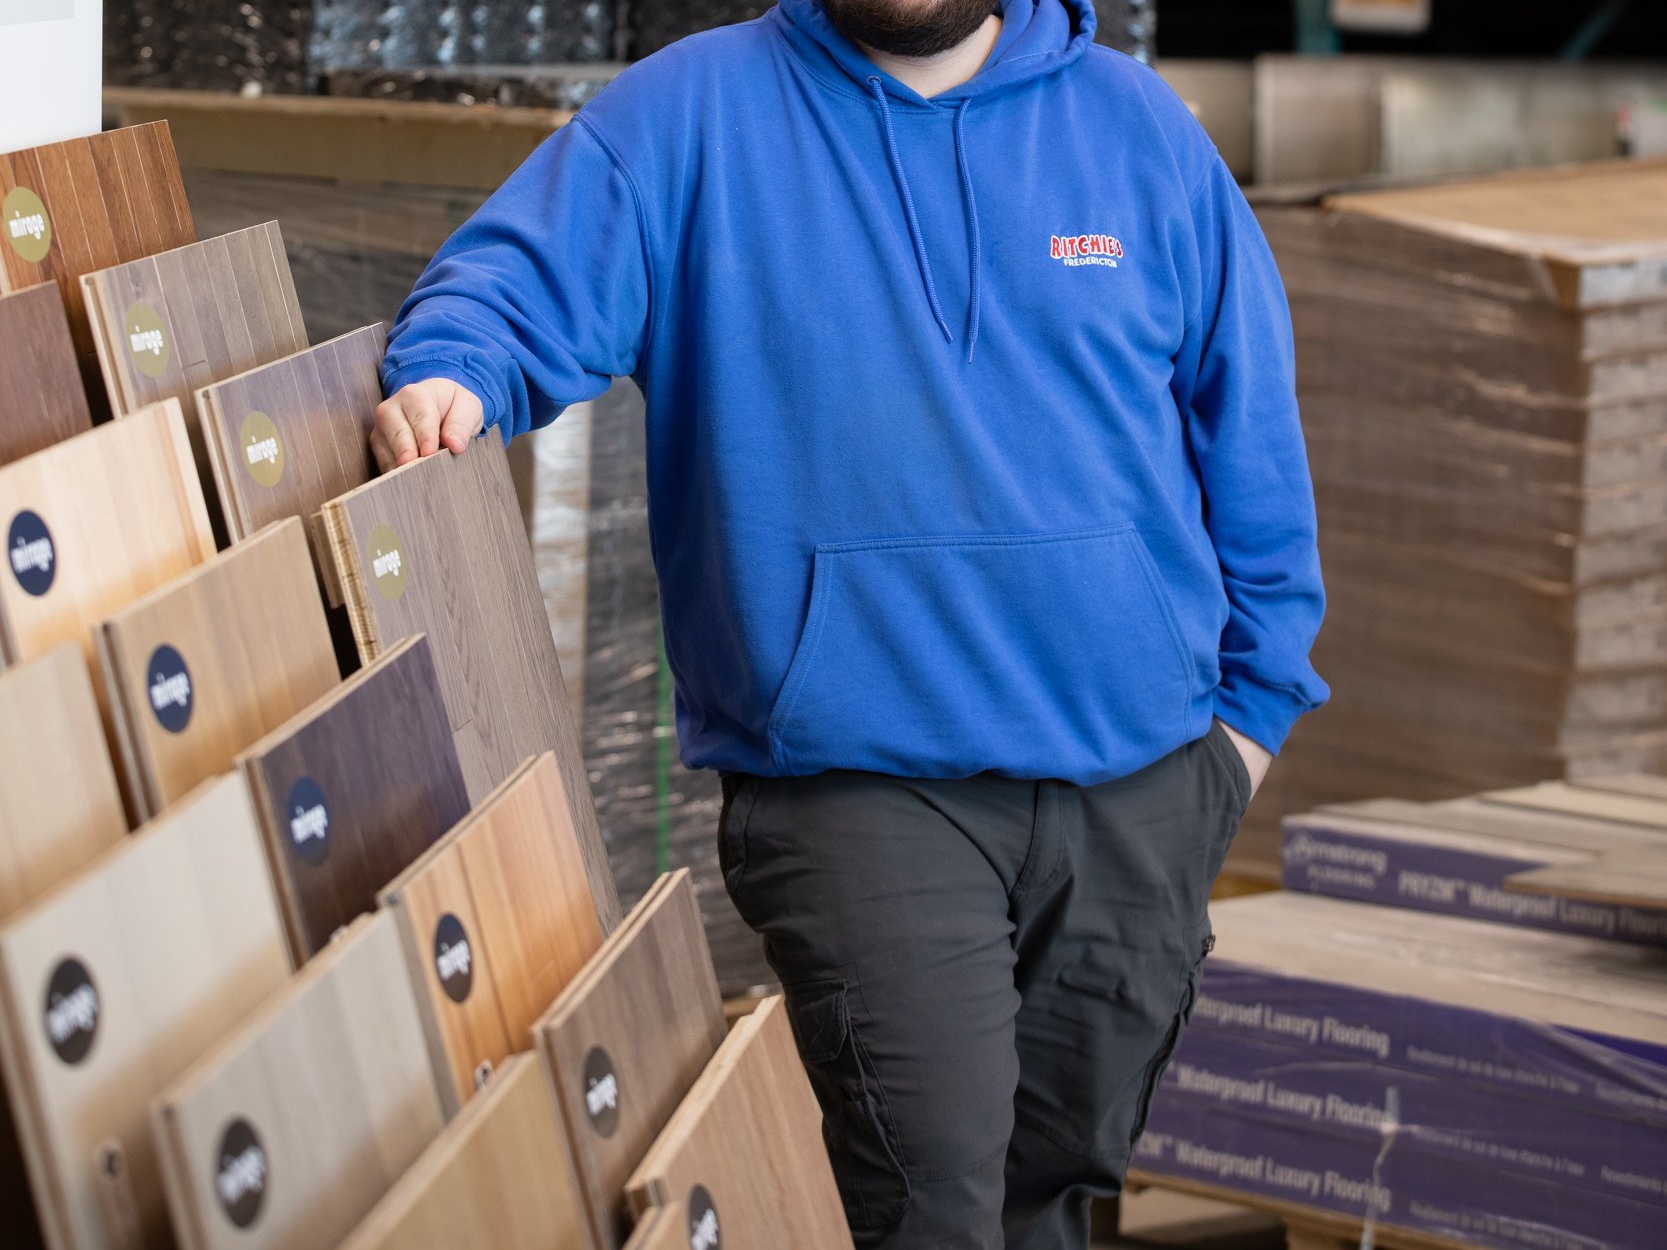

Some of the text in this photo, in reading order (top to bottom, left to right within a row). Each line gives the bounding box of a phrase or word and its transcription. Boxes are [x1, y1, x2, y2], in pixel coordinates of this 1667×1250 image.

[9, 210, 46, 240] mirage
[1063, 255, 1118, 269] FREDERICTON
[130, 325, 164, 356] mirage
[246, 436, 278, 465] mirage
[373, 549, 401, 578] mirage
[1264, 1005, 1319, 1045] Luxury
[1322, 1016, 1391, 1060] Flooring
[1178, 1063, 1265, 1103] Waterproof
[1266, 1080, 1323, 1121] Luxury
[1176, 1138, 1264, 1179] Waterproof
[1265, 1156, 1320, 1198] Luxury
